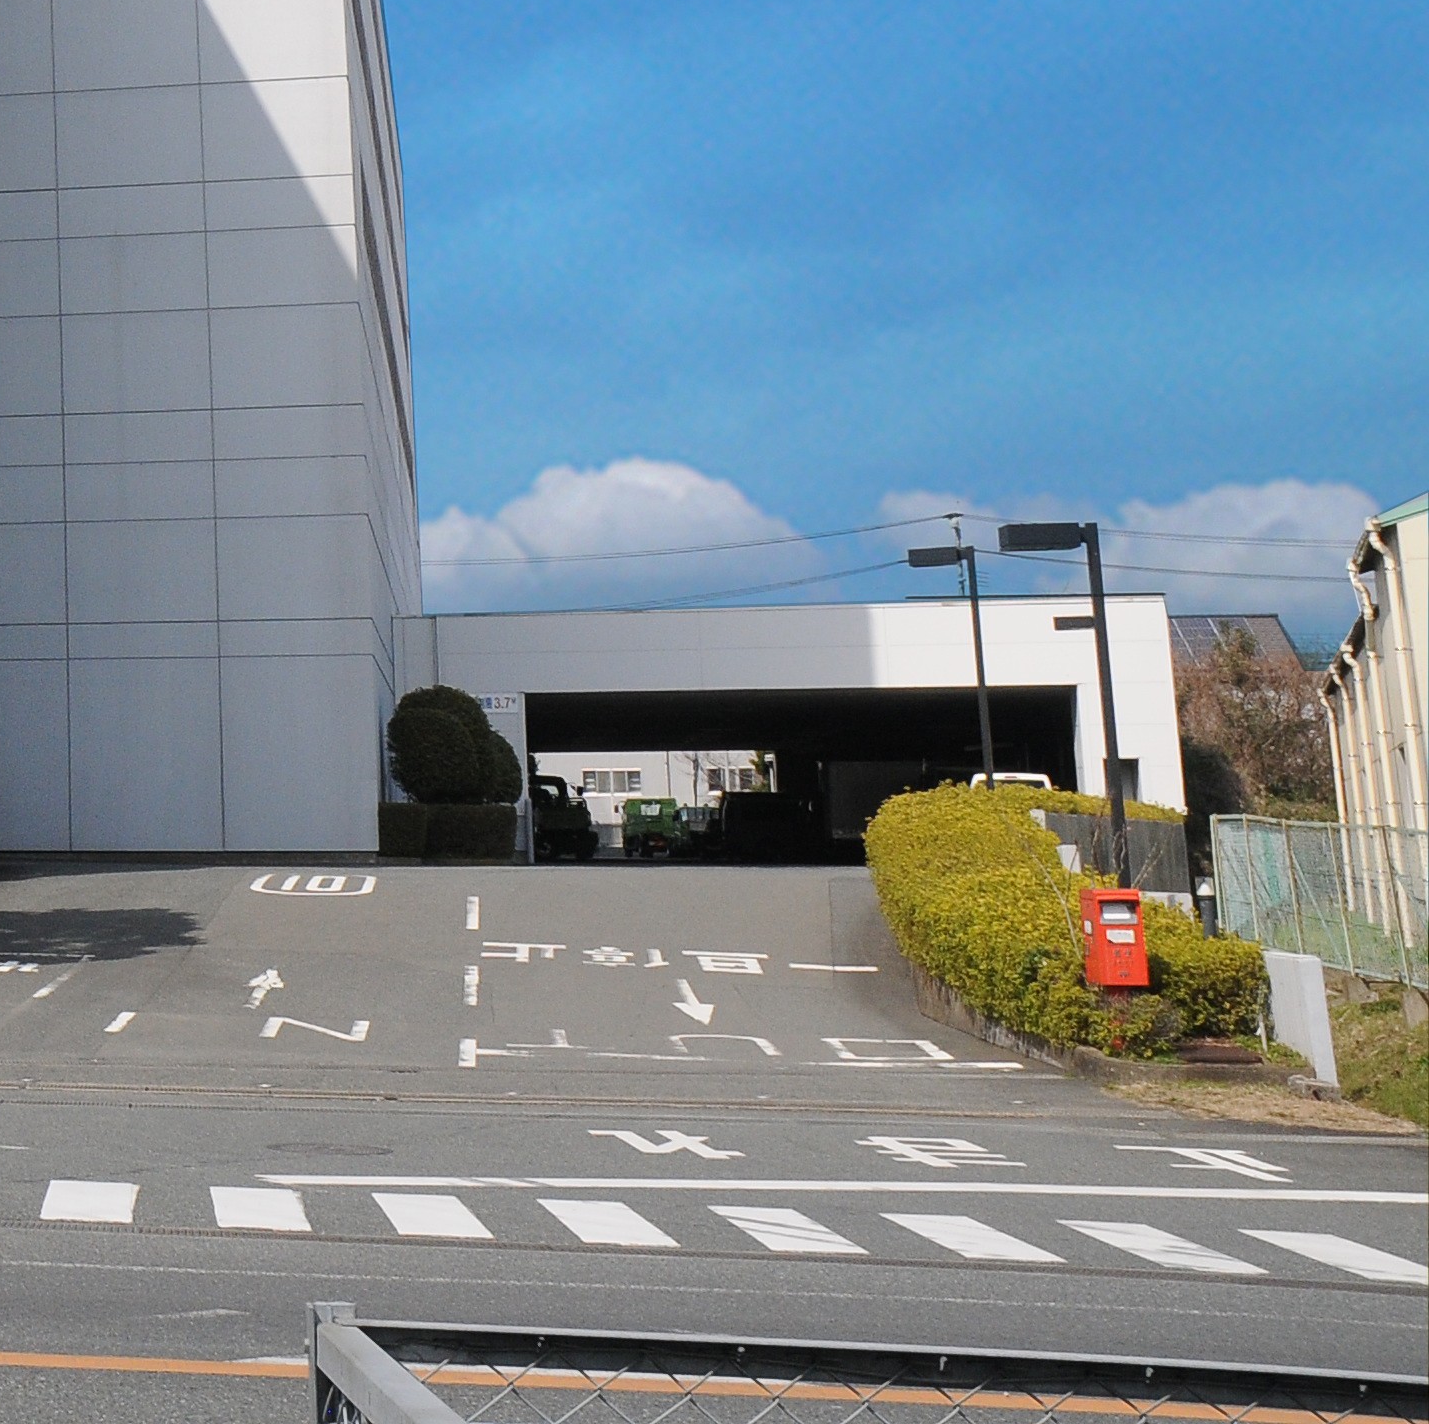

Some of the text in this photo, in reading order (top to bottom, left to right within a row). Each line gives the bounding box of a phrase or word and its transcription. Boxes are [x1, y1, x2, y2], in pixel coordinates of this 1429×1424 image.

[481, 941, 879, 975] 一旦停止
[588, 1128, 1293, 1183] 止まれ
